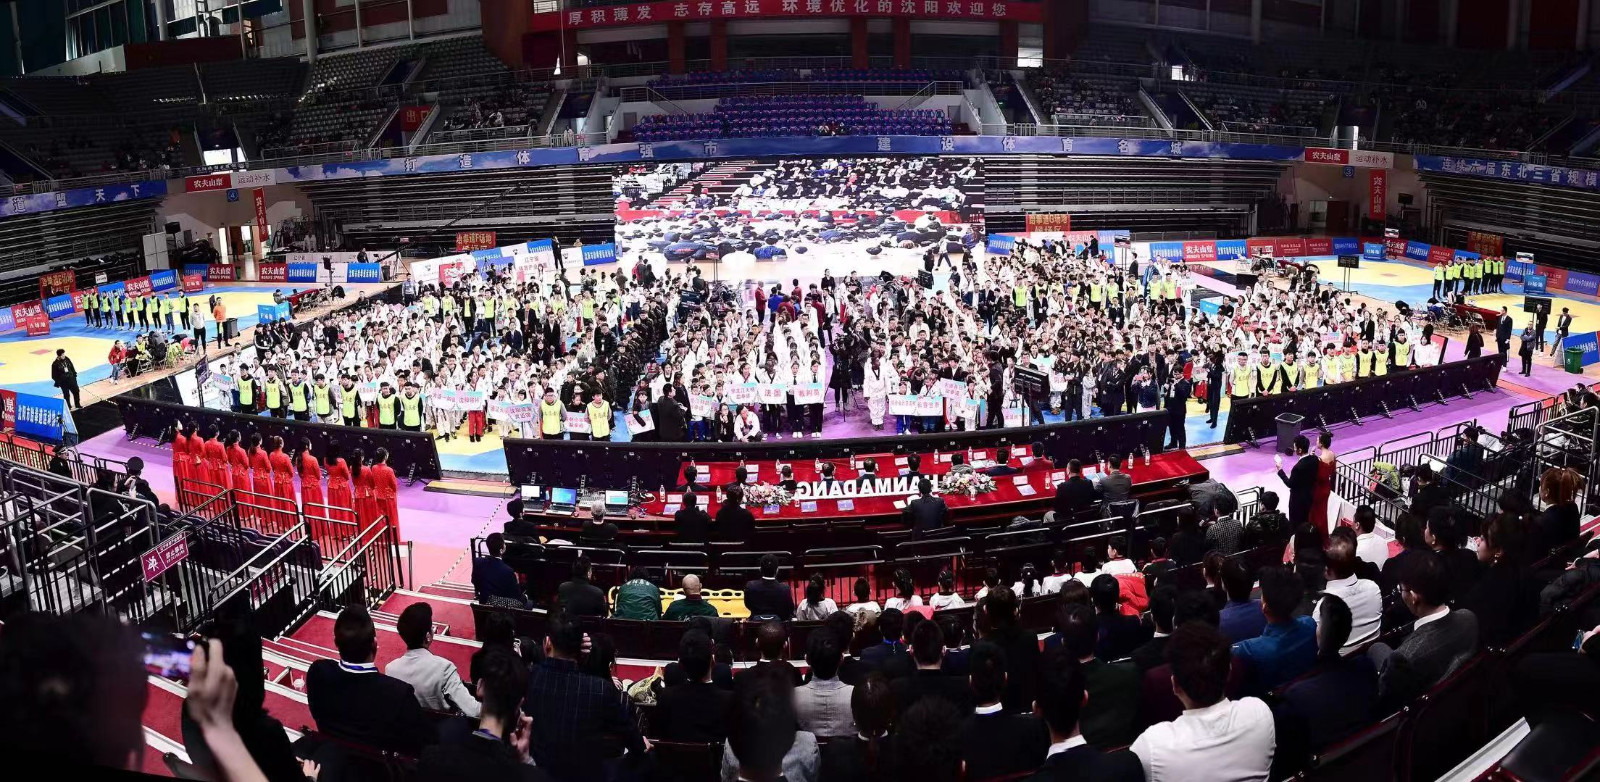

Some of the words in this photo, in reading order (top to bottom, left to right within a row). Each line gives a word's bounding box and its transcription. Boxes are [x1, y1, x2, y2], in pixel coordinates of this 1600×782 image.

[568, 6, 652, 25] 厚积薄发
[674, 1, 761, 17] 志存高远
[782, 0, 1007, 16] 环境优化的沈阳欢迎您
[1312, 151, 1341, 161] 农夫山泉
[1441, 158, 1597, 187] 连续六届东北三省规模
[193, 177, 223, 188] 农夫山泉
[11, 184, 140, 213] 道盟天下
[1186, 245, 1213, 254] 农夫山泉
[209, 267, 231, 275] 农夫山泉
[261, 267, 285, 275] 农夫山泉
